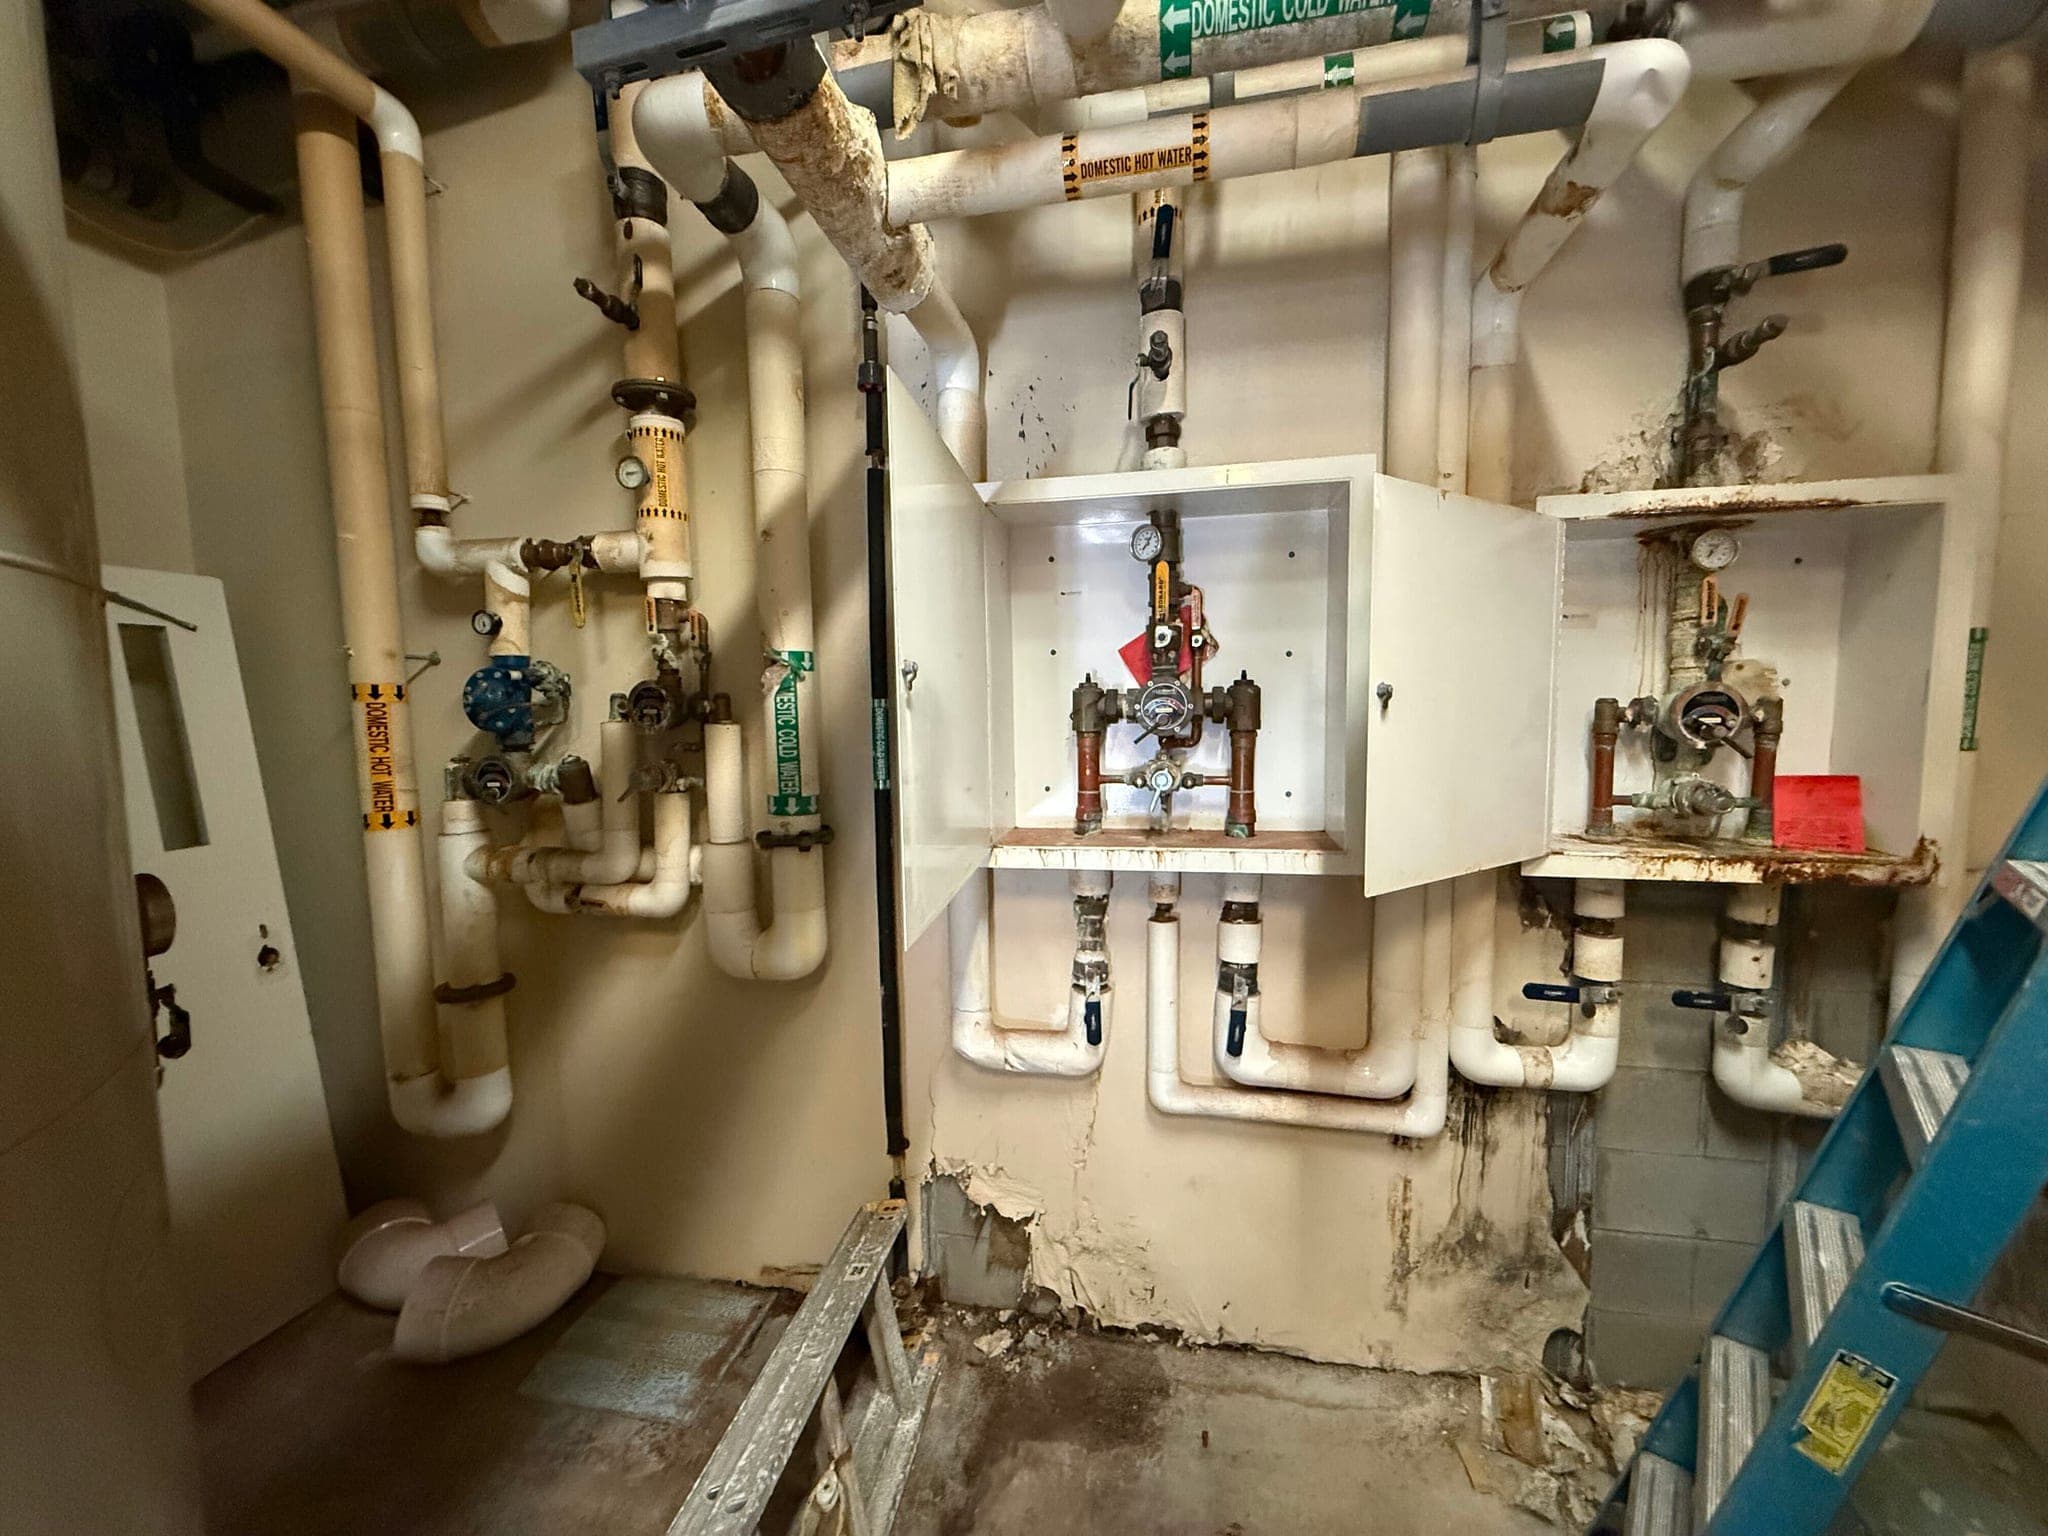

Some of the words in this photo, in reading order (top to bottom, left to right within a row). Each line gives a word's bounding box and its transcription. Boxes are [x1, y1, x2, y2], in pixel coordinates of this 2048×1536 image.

[1191, 0, 1276, 38] DOMESTIC
[1080, 156, 1132, 180] DOMESTIC
[1134, 151, 1155, 171] HOT
[1157, 145, 1192, 168] WATER
[656, 460, 666, 474] HOT
[657, 474, 668, 507] DOMESTIC
[365, 702, 390, 753] DOMESTIC
[778, 729, 798, 758] COLD
[370, 756, 392, 776] HOT
[779, 761, 800, 795] WATER
[372, 780, 395, 813] WATER
